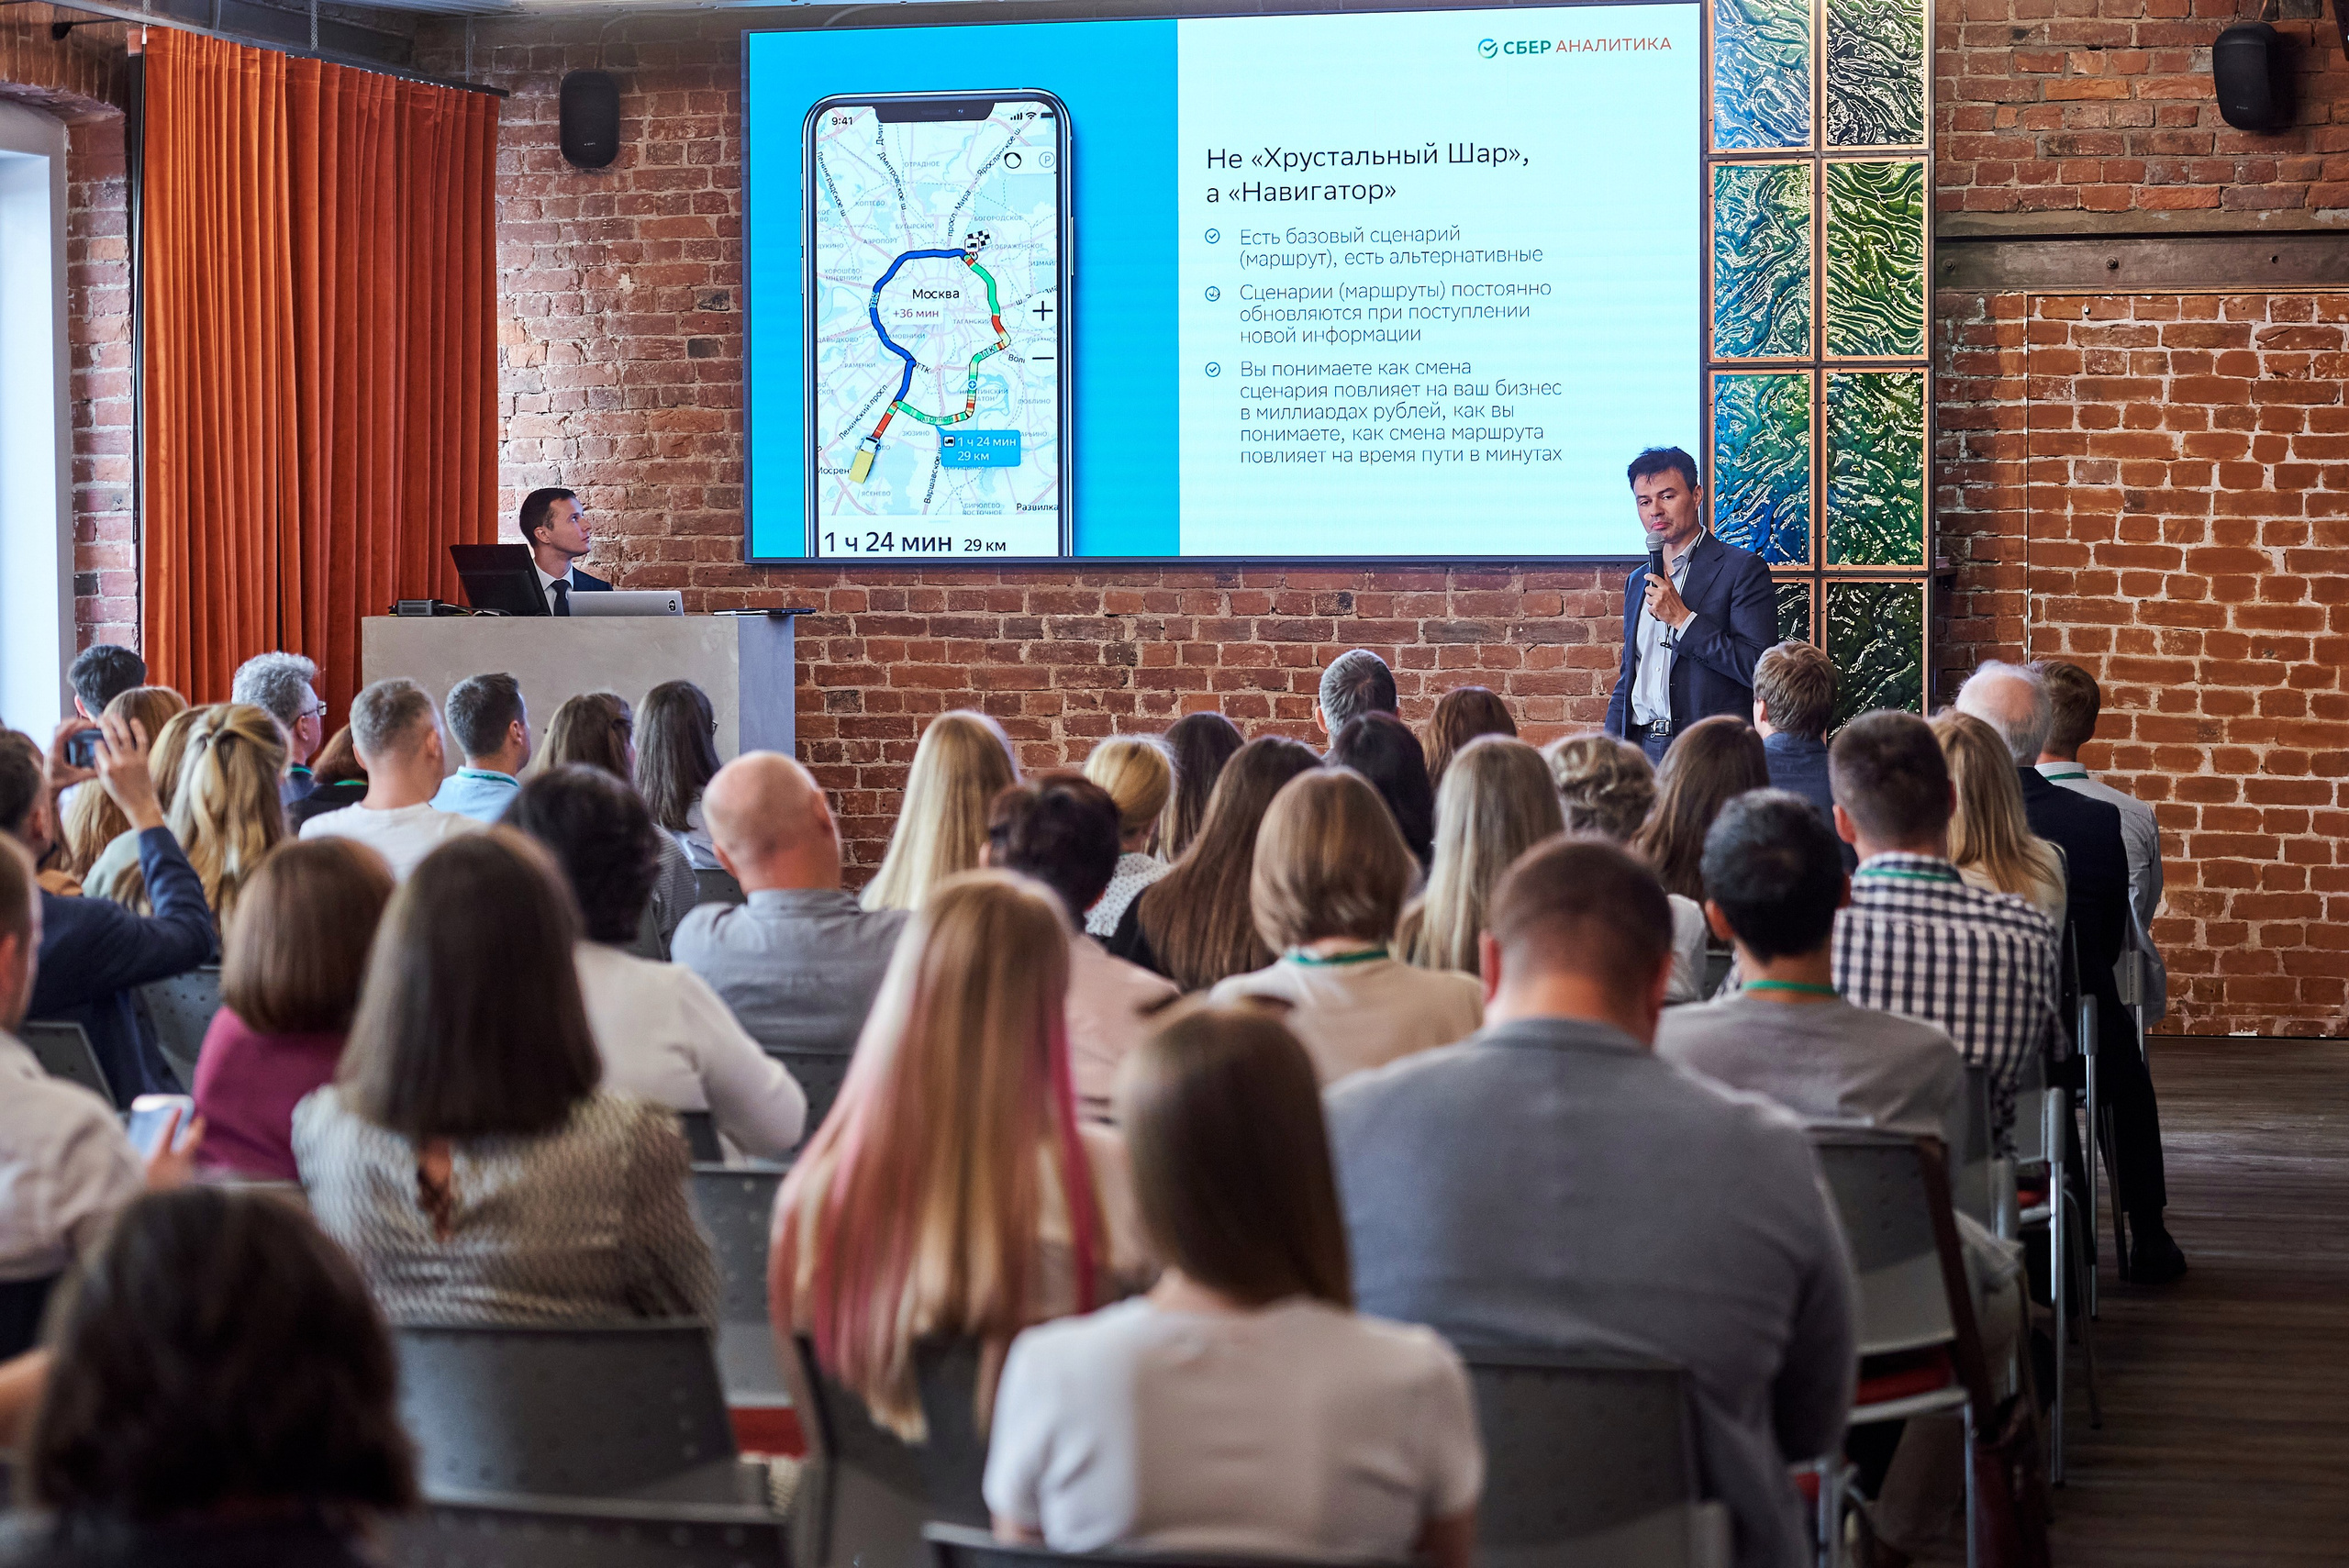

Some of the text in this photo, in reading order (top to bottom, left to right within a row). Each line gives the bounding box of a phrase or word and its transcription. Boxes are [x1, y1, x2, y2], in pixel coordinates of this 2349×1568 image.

[1504, 37, 1673, 55] СБЕР АНАЛИТИКА
[831, 117, 853, 126] 9:41
[1207, 141, 1530, 173] Не «Хрустальный Шар»,
[1206, 181, 1397, 205] а «Навигатор»
[1241, 224, 1460, 246] Есть базовый сценарий
[1239, 248, 1543, 271] (маршрут), есть альтернативные
[912, 288, 961, 300] Москва
[1240, 280, 1552, 304] Сценарии (маршруты) постоянно
[893, 308, 940, 318] +36 мин
[1240, 304, 1531, 324] обновляются при поступлении
[1241, 325, 1421, 346] новой информации
[1241, 361, 1472, 377] Вы понимаете как смена
[1240, 378, 1563, 402] сценария повлияет на ваш бизнес
[1241, 401, 1514, 423] в миллиардах рублей, как вы
[957, 437, 1017, 447] 1 ч 24 мин
[1241, 426, 1544, 445] понимаете, как смена маршрута
[957, 450, 990, 462] 29 км
[1241, 448, 1563, 467] повлияет на время пути в минутах
[824, 531, 1007, 552] 1 ч 24 мин 29 км
